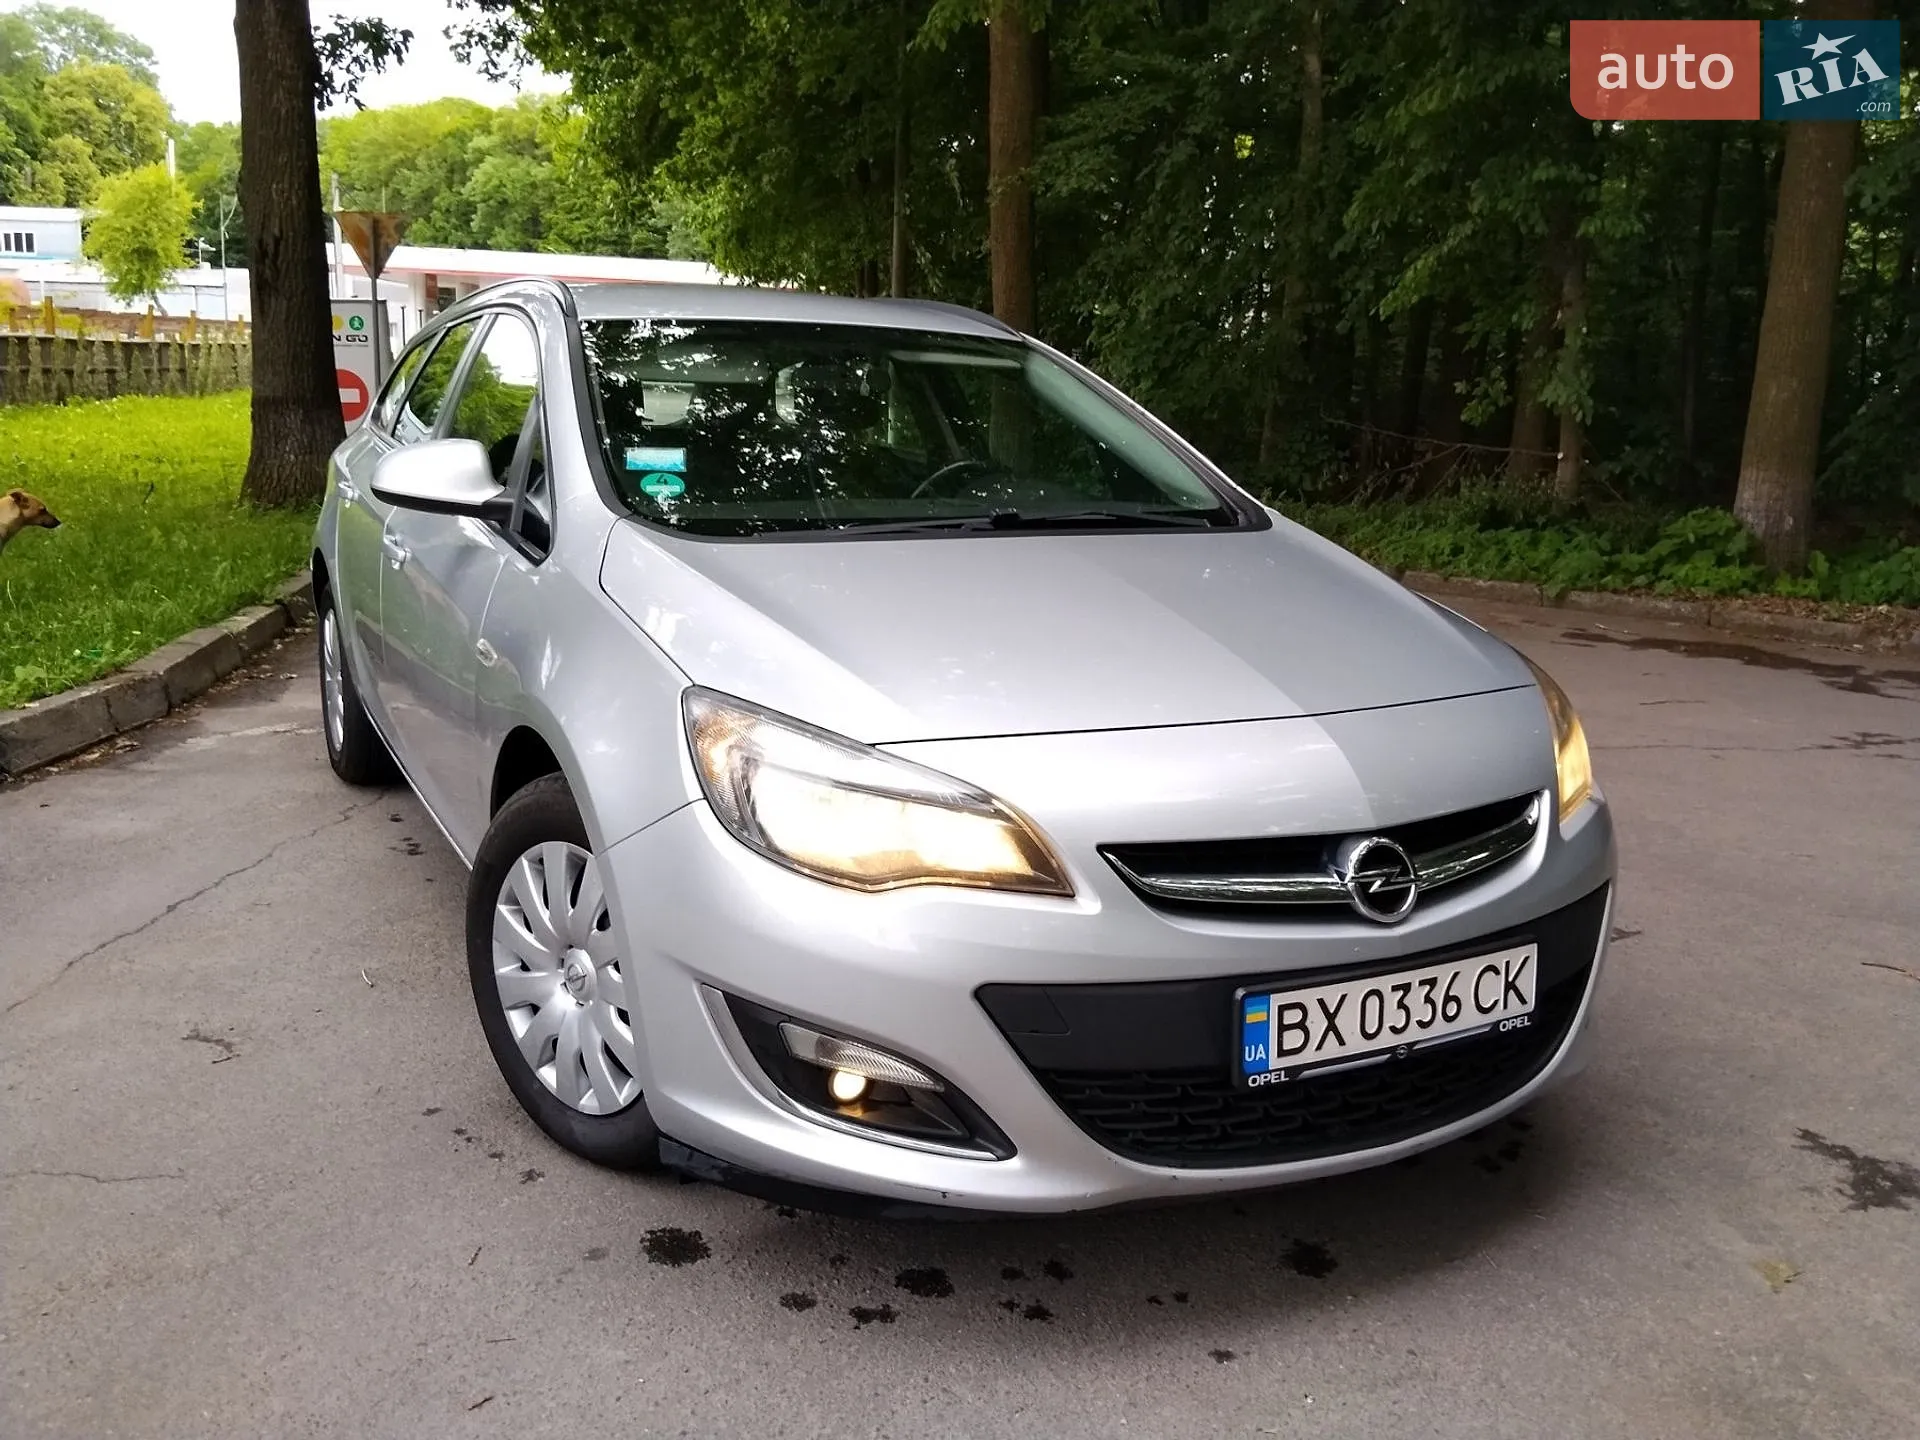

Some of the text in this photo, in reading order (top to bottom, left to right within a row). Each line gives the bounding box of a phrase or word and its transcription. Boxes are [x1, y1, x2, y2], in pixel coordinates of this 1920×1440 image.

[345, 333, 368, 343] GO
[656, 473, 668, 485] 4
[1276, 955, 1531, 1058] BX 0336 CK
[1499, 1015, 1531, 1032] OPEL
[1244, 1043, 1267, 1061] UA
[1248, 1070, 1290, 1087] OPEL
